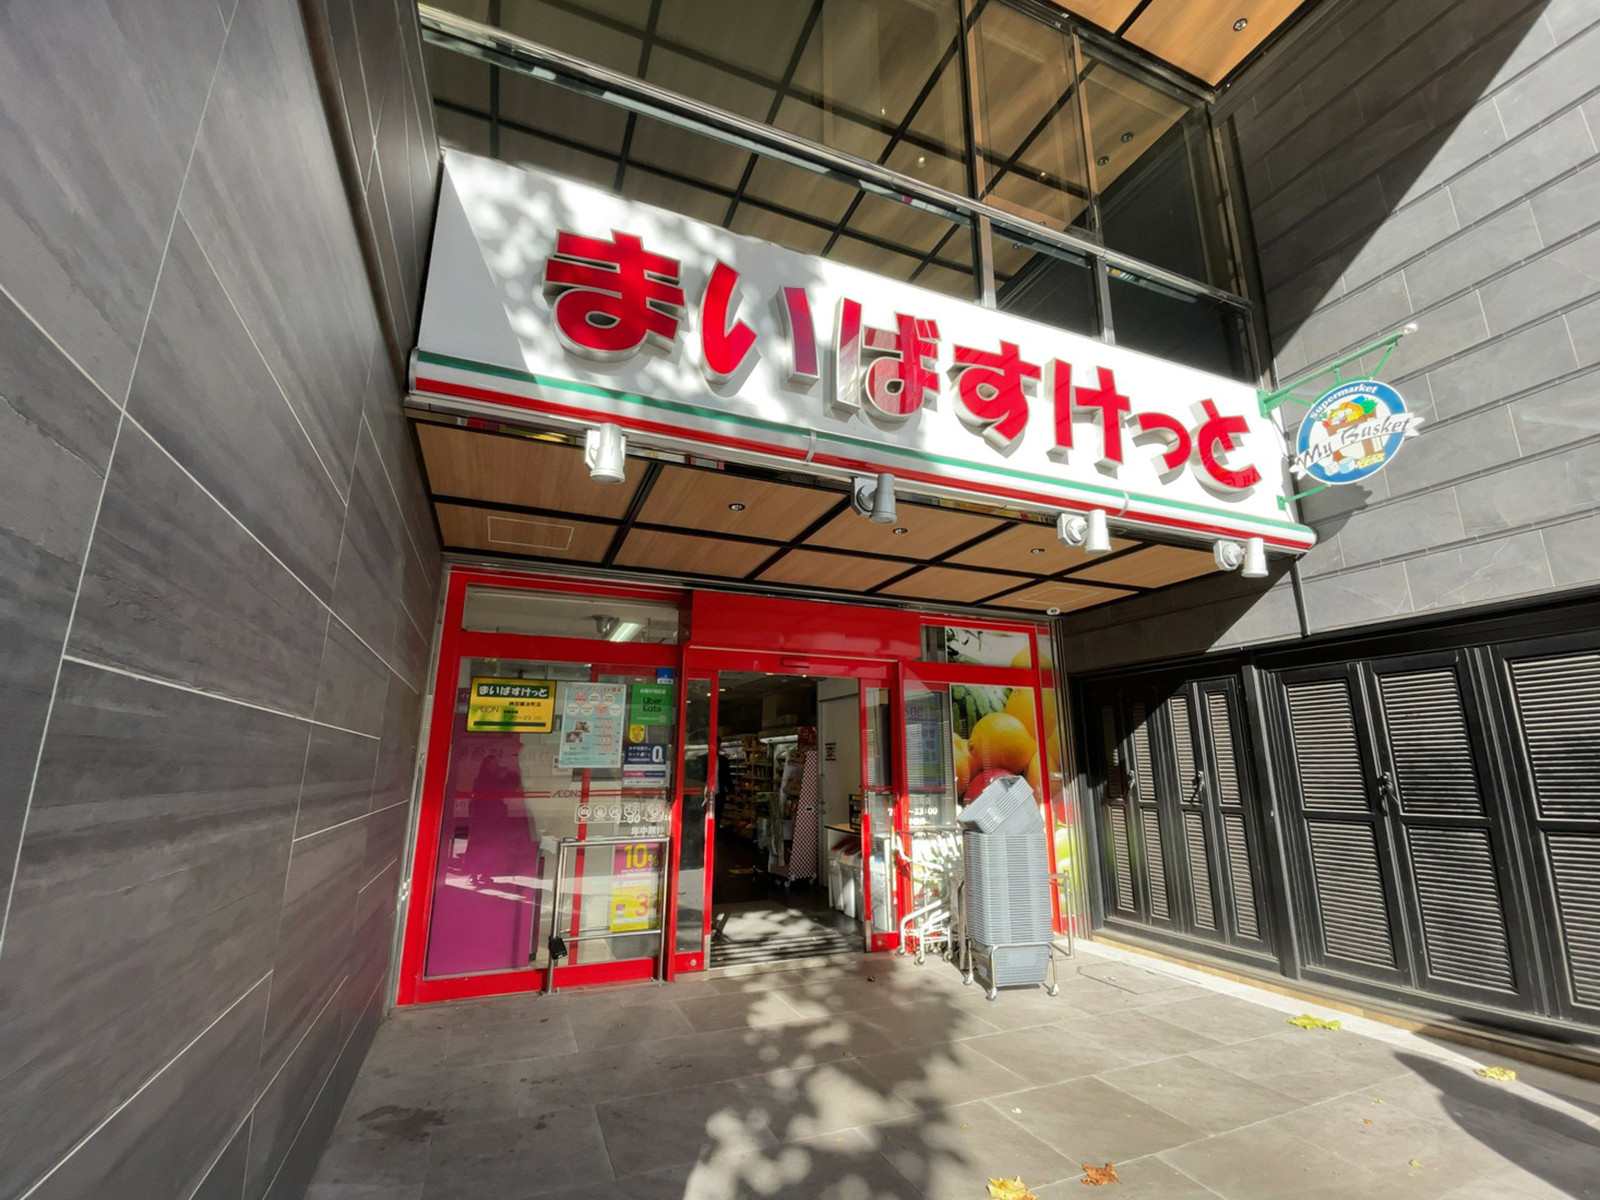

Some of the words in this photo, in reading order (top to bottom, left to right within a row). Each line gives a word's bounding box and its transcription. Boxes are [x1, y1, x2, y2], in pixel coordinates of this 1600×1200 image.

[544, 228, 1262, 492] まいばすけっと
[1310, 383, 1378, 419] Supermarket
[1296, 442, 1333, 468] My
[1341, 415, 1411, 445] Basket
[479, 685, 547, 697] まいばすけっと
[625, 844, 659, 869] 10%
